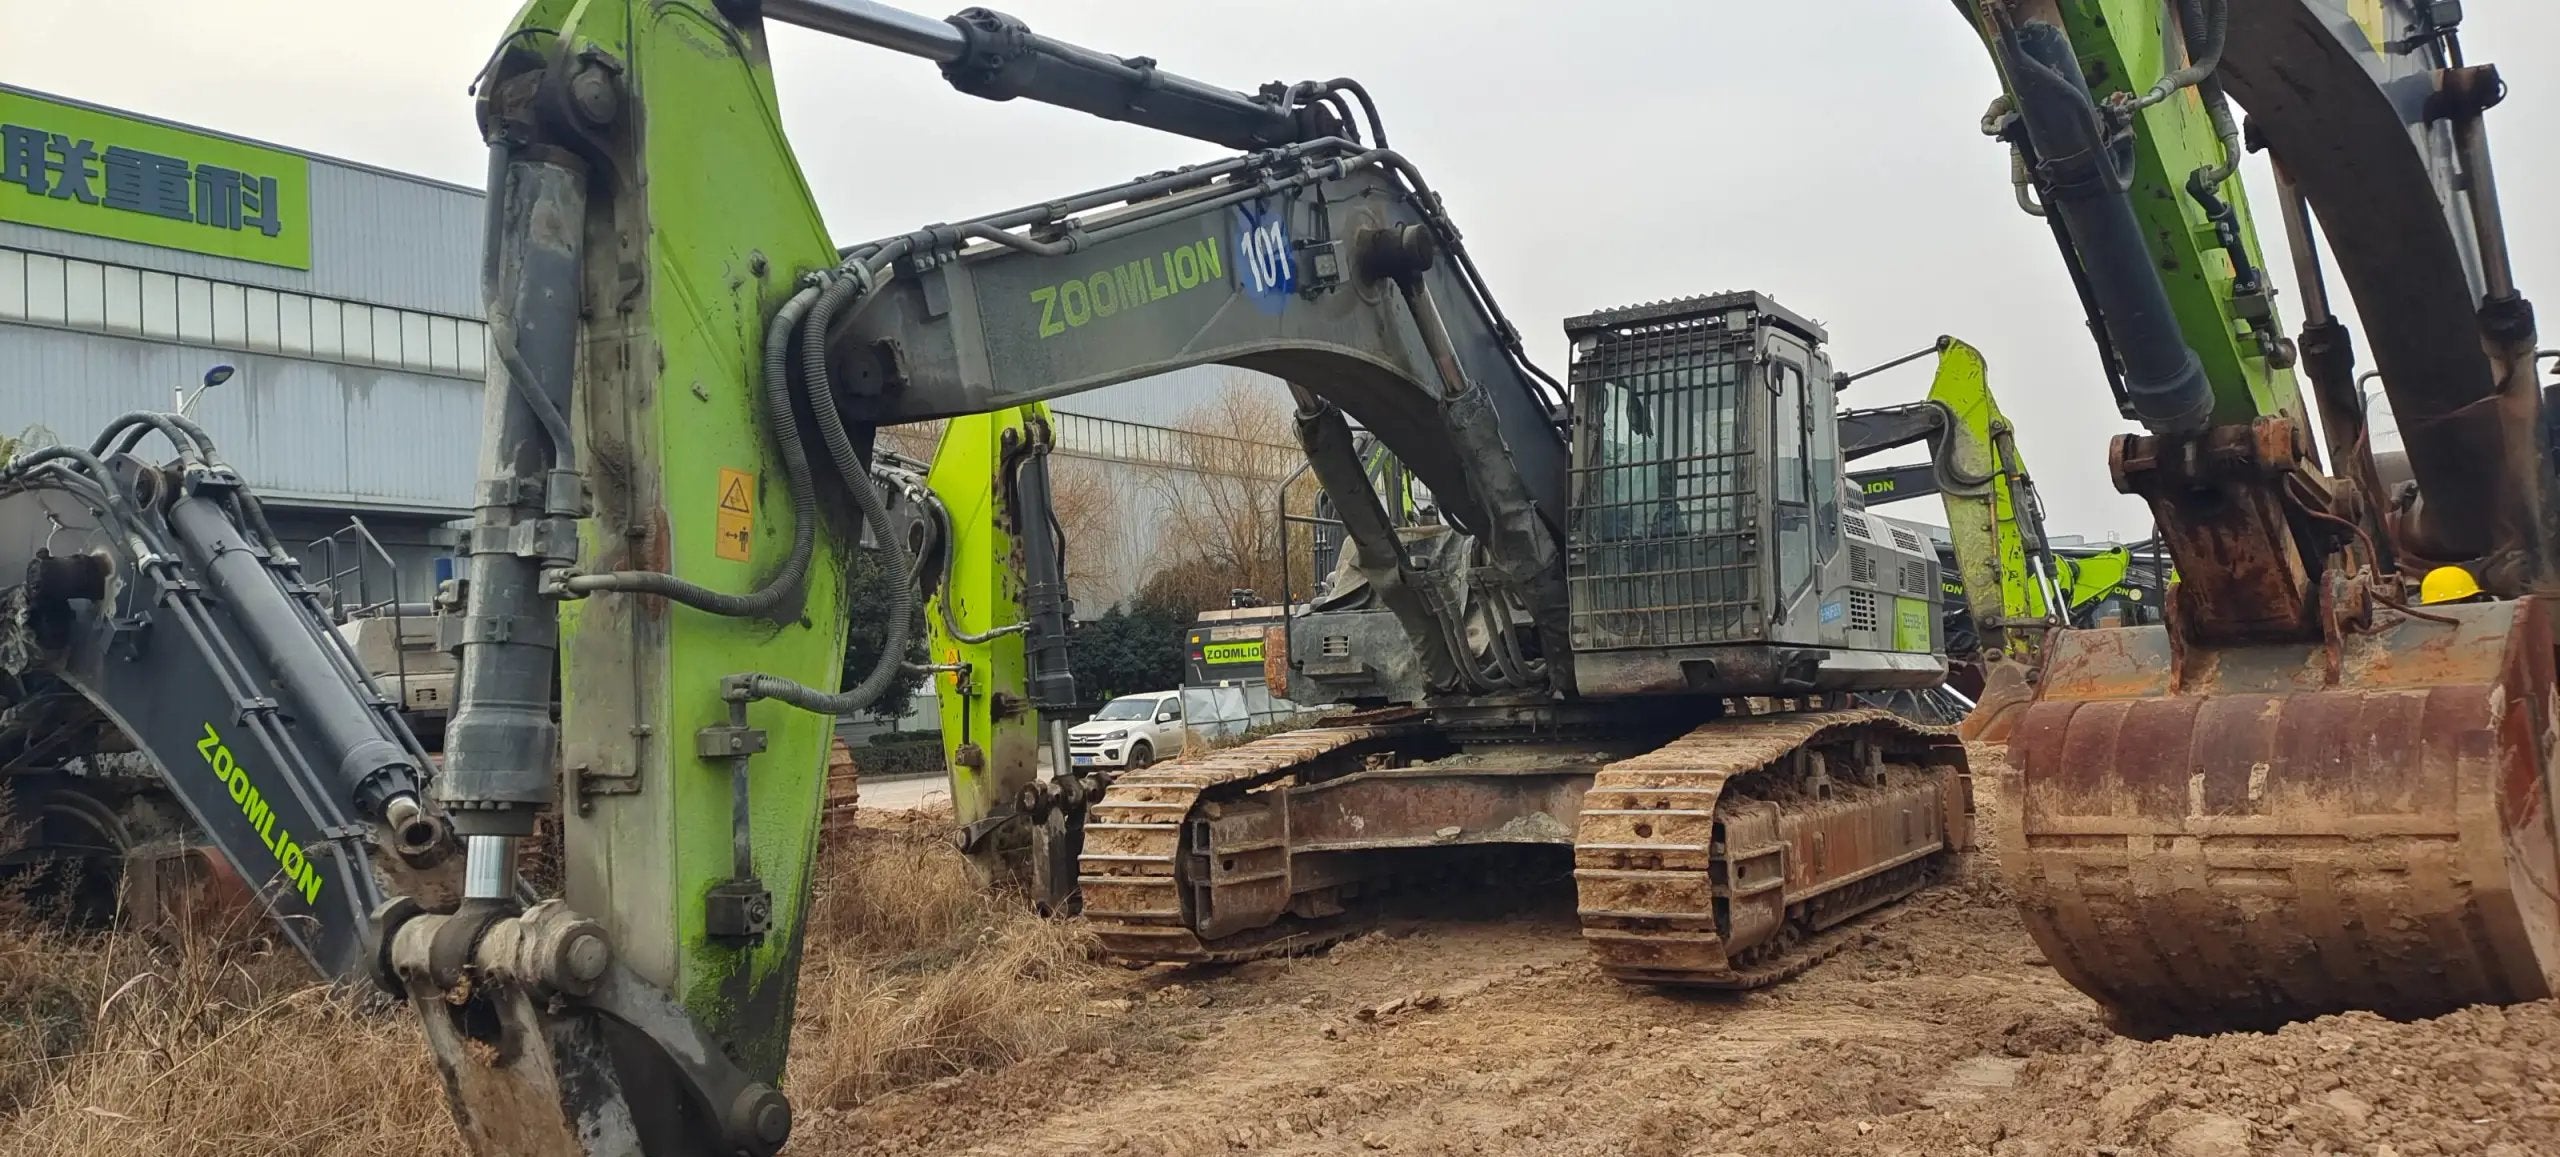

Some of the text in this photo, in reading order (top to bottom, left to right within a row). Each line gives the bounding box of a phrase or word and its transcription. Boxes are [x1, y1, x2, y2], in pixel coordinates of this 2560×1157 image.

[1030, 237, 1222, 339] ZOOMLION
[1242, 221, 1291, 293] 101
[196, 721, 323, 906] ZOOMLION
